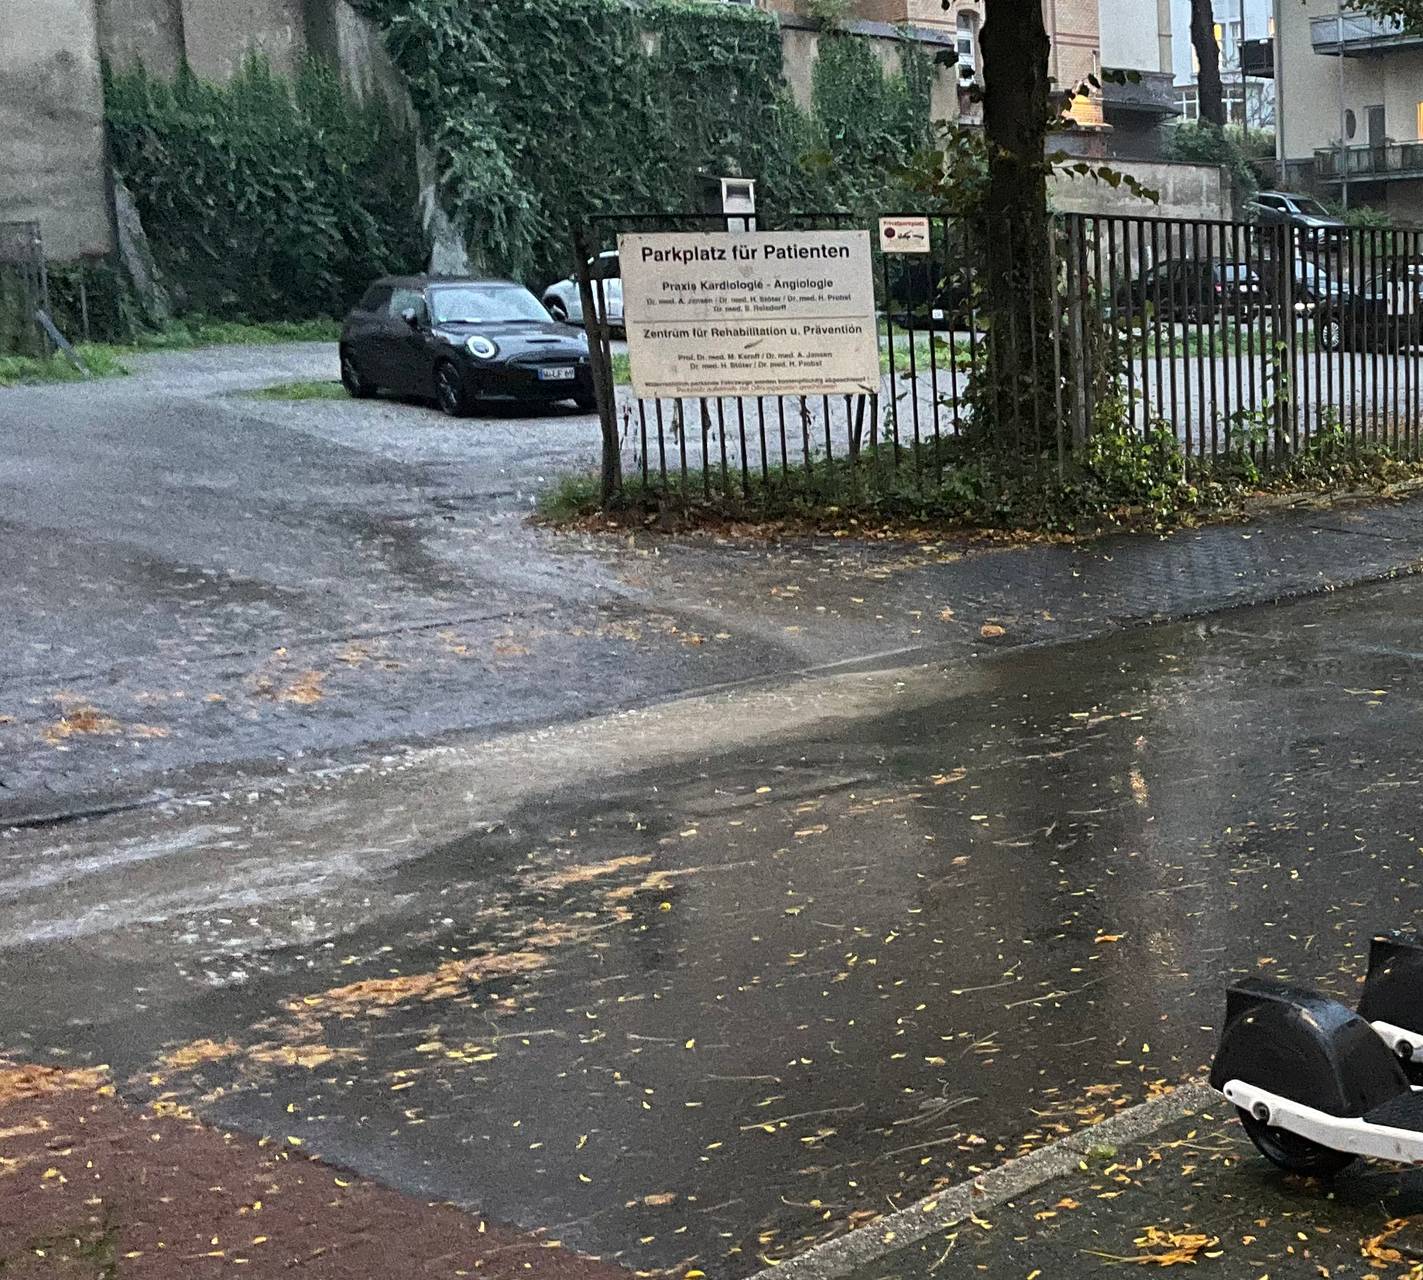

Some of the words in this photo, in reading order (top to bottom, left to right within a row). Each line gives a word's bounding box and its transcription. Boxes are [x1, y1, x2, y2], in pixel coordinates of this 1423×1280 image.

[642, 246, 727, 265] Parkplatz
[732, 245, 757, 261] für
[764, 244, 850, 259] Patienten
[662, 281, 697, 291] Praxis
[700, 280, 763, 291] Kardiologie
[774, 279, 834, 290] Angiologie
[643, 328, 690, 339] Zentrum
[692, 327, 708, 338] für
[711, 326, 787, 337] Rehabilitation
[790, 327, 801, 335] u.
[803, 324, 862, 335] Prävention
